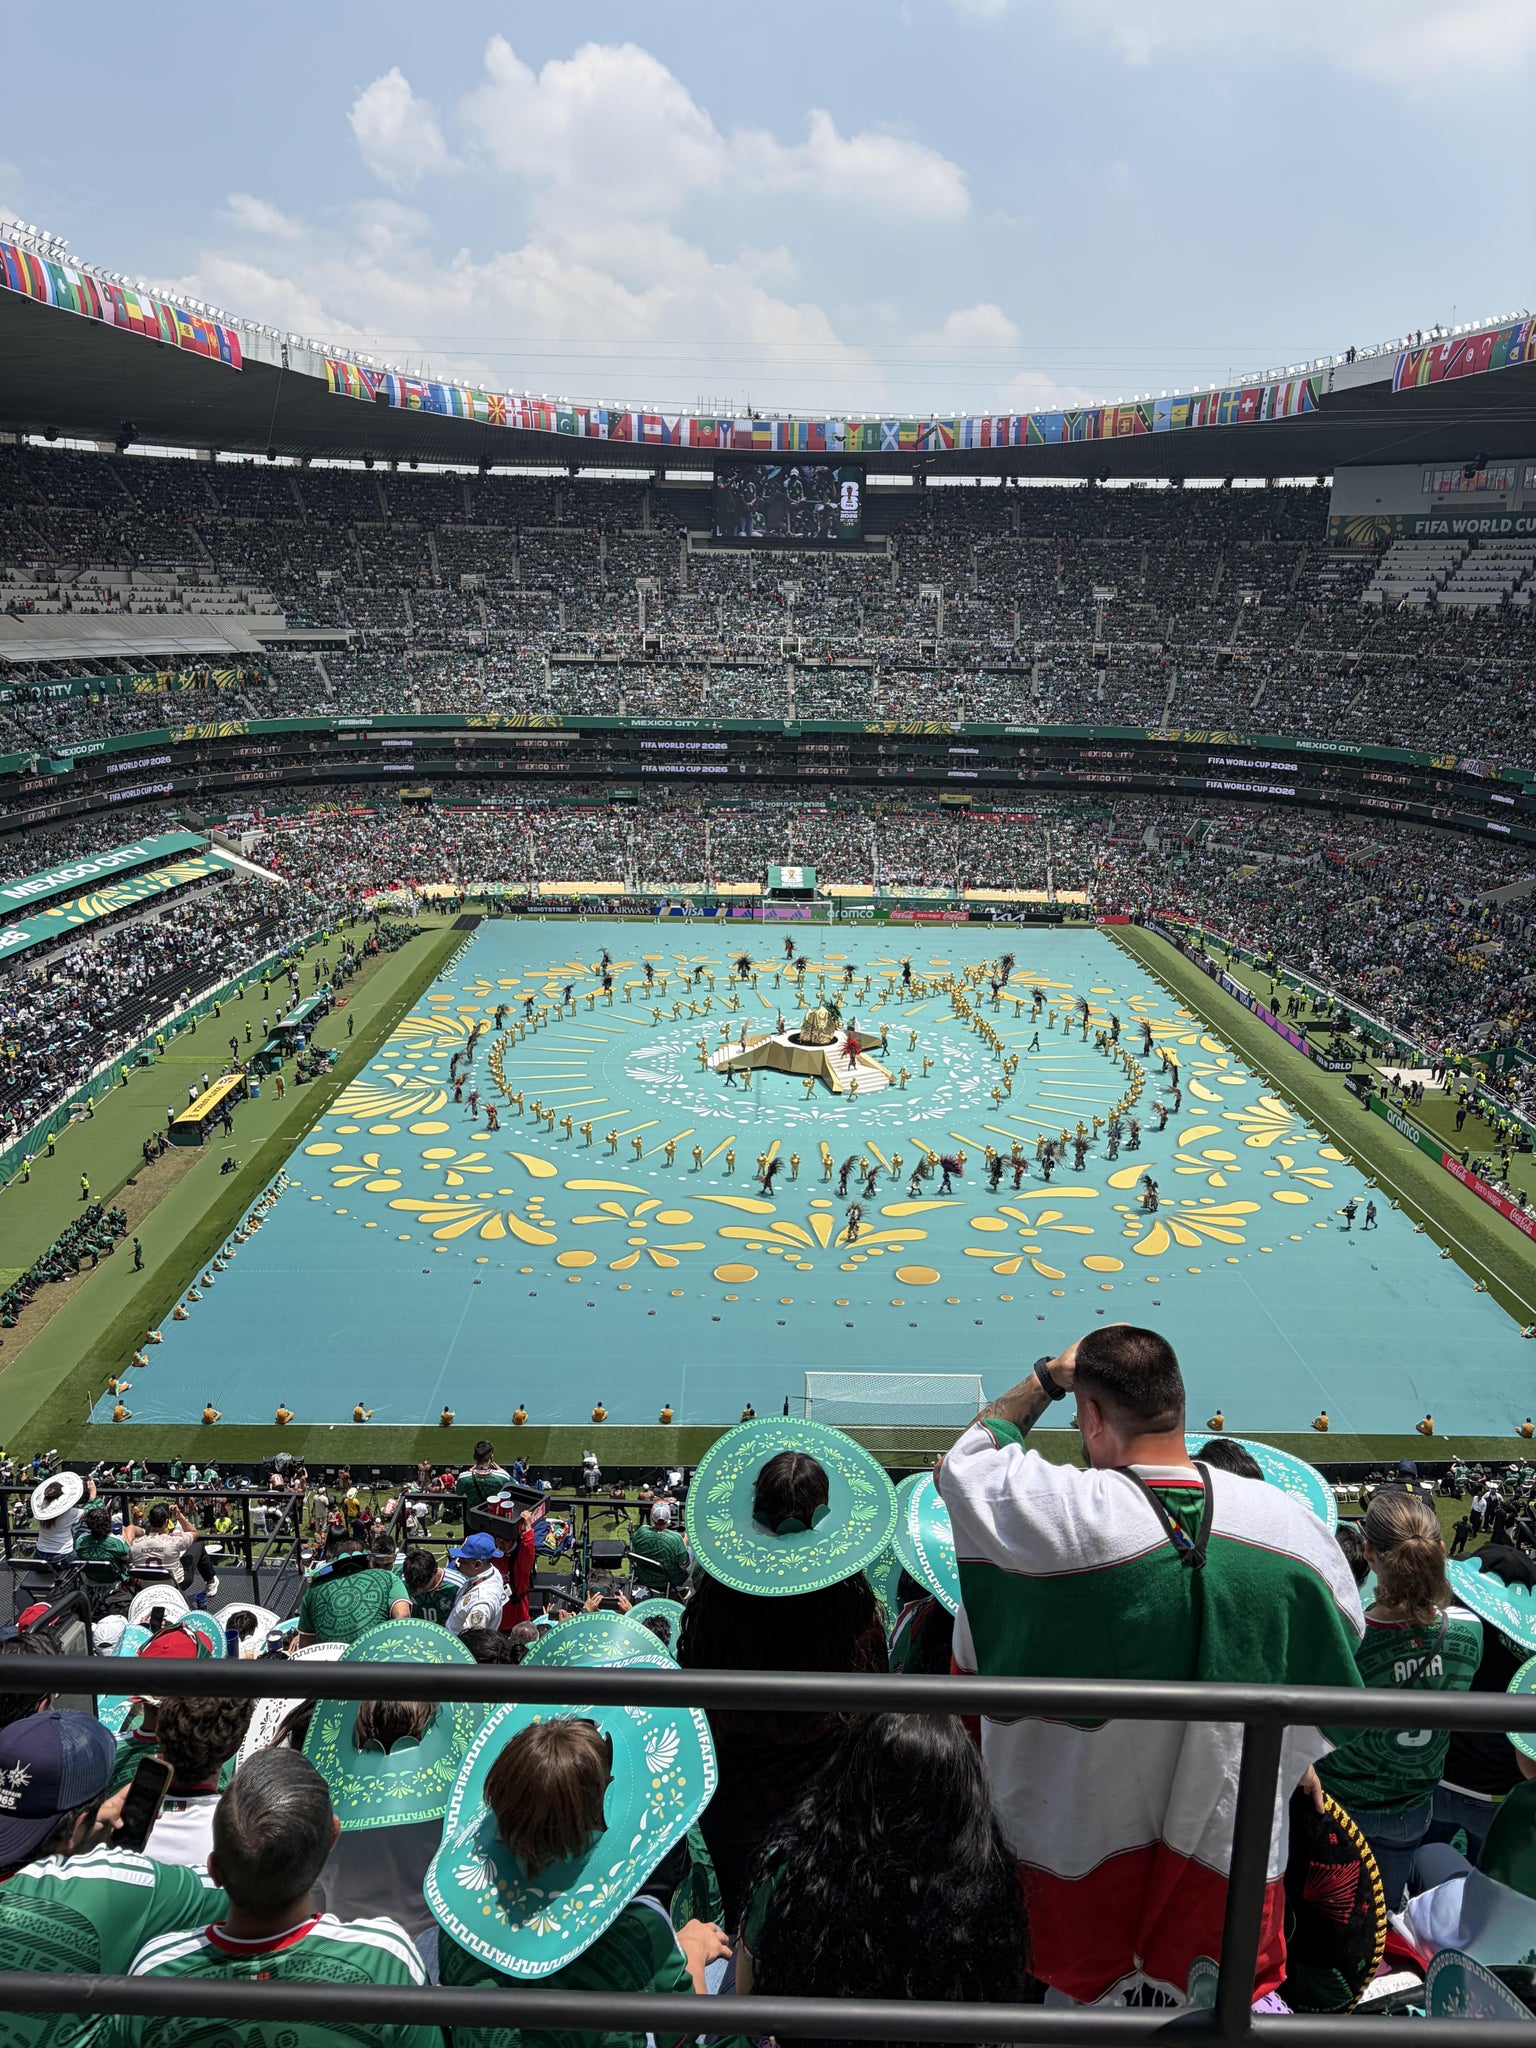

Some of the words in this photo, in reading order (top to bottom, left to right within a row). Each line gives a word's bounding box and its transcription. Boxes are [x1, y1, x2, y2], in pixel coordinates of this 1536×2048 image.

[1415, 520, 1449, 534] FIFA
[1452, 518, 1512, 534] WORLD
[88, 742, 105, 752] CITY
[640, 742, 656, 750] FIFA
[658, 742, 684, 750] WORLD
[686, 742, 701, 750] CUP
[1296, 741, 1337, 751] MEXICO
[1338, 744, 1362, 754] CITY
[106, 764, 118, 774] FIFA
[118, 761, 138, 772] WORLD
[138, 758, 150, 768] CUP
[150, 756, 172, 766] 2026
[641, 765, 657, 773] FIFA
[658, 765, 684, 773] WORLD
[1208, 756, 1225, 765] FIFA
[1226, 758, 1254, 768] WORLD
[1270, 762, 1298, 771] 2026
[110, 791, 121, 802] FIFA
[121, 788, 140, 800] WORLD
[140, 786, 152, 796] CUP
[1206, 780, 1222, 789] FIFA
[1224, 782, 1251, 792] WORLD
[1252, 784, 1268, 792] CUP
[1268, 786, 1296, 796] 2026
[525, 798, 550, 806] CITY
[992, 806, 1033, 814] MEXICO
[2, 864, 100, 900] MEXICO
[94, 846, 150, 868] CITY
[578, 906, 609, 914] QATAR
[612, 906, 651, 914] AIRWAYS
[682, 908, 704, 916] VISA
[827, 910, 874, 918] aramco
[1386, 1109, 1420, 1144] aramco
[755, 1586, 775, 1594] FIFA
[932, 1580, 952, 1604] FIFA
[422, 1608, 437, 1622] 10
[586, 1614, 607, 1622] FIFA
[416, 1620, 436, 1632] FIFA
[360, 1628, 380, 1642] FIFA
[536, 1632, 553, 1650] FIFA
[638, 1628, 659, 1644] FIFA
[696, 1723, 712, 1753] FIFA
[454, 1764, 473, 1798] FIFA
[2, 1789, 22, 1798] REPAIR
[412, 1810, 432, 1820] FIFA
[346, 1817, 370, 1828] FIFA
[434, 1894, 456, 1926] FIFA
[494, 1950, 521, 1972] FIFA
